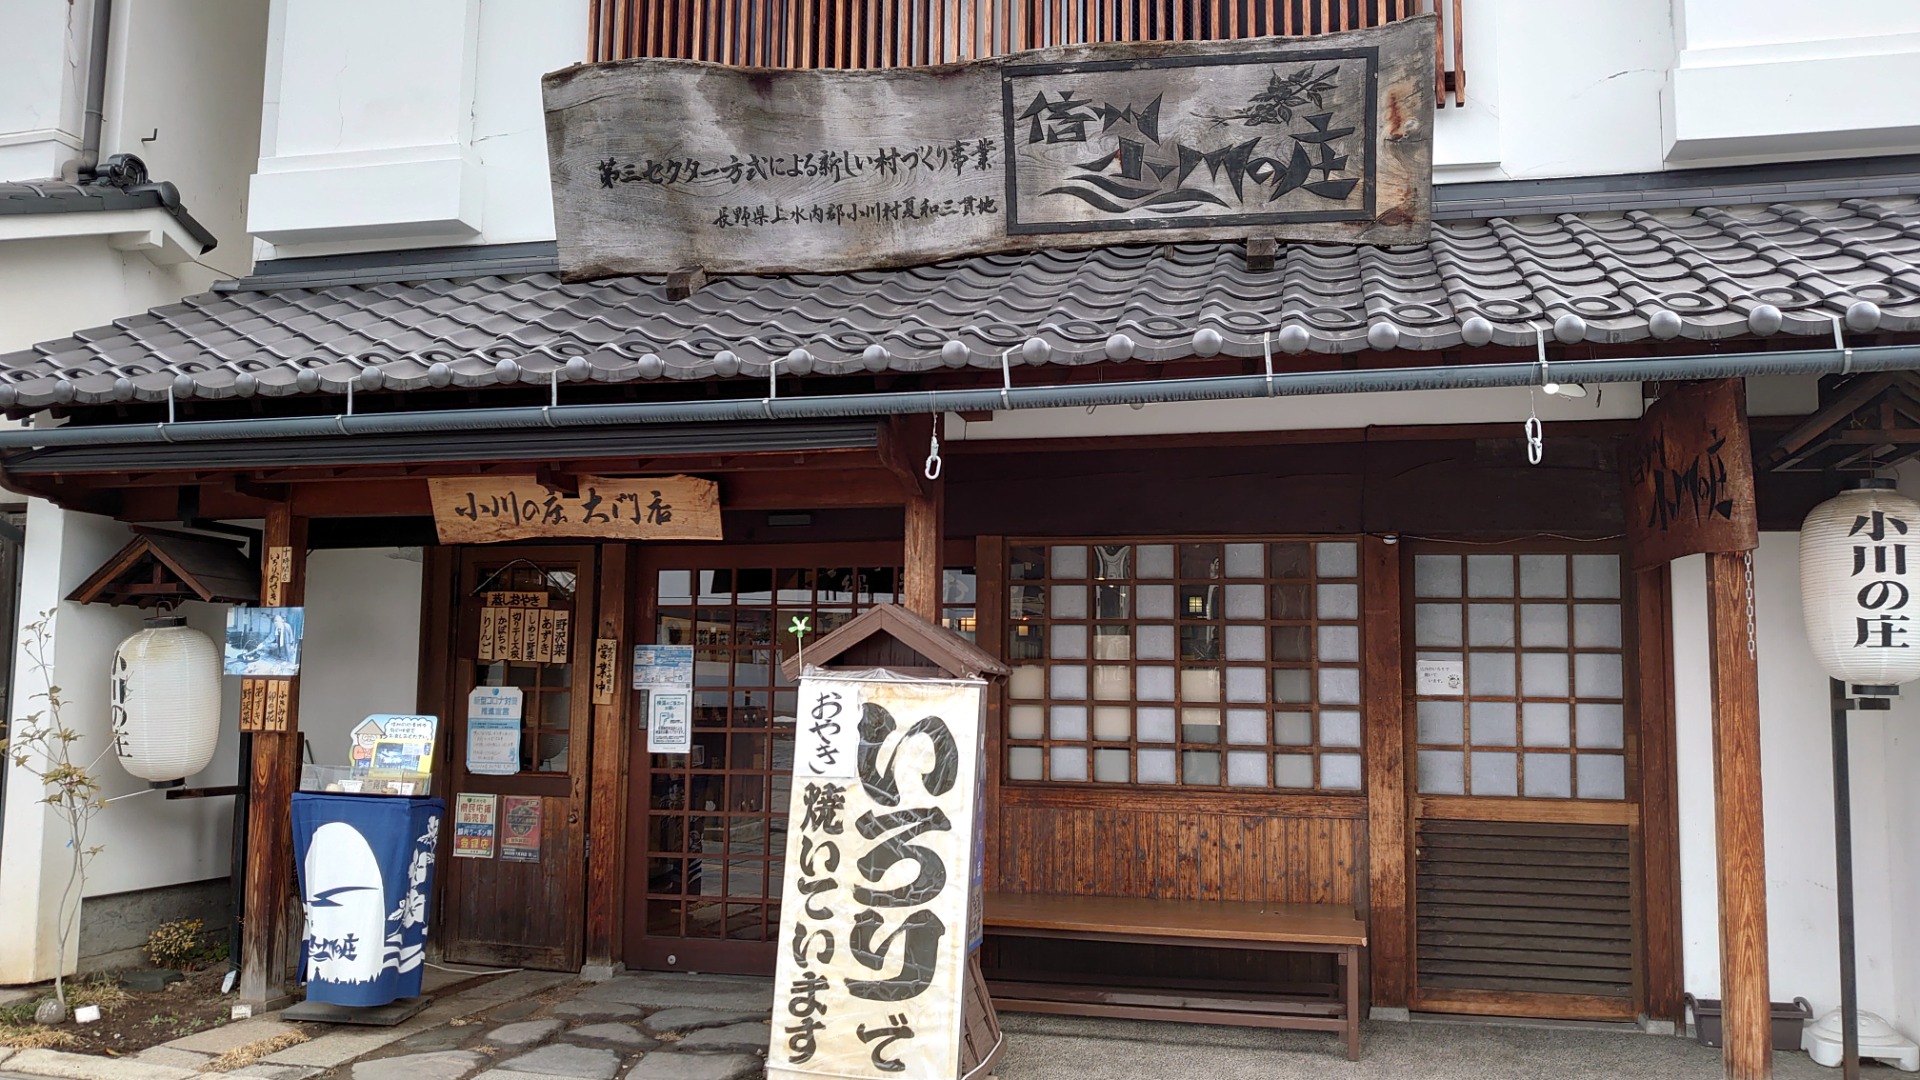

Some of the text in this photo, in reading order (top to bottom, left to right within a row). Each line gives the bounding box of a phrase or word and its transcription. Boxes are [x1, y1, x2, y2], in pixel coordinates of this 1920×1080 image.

[1017, 90, 1163, 145] 信州
[598, 137, 997, 190] 第三セクター方式による新しい村づくり事業
[1073, 112, 1360, 203] 小川の庄
[454, 487, 673, 526] 小川の庄 大門店
[491, 593, 540, 607] 蒸しおやき
[1847, 510, 1911, 649] 小川の庄
[481, 616, 491, 654] りんご
[498, 616, 507, 654] かぼちゃ
[541, 615, 552, 655] あずき
[553, 618, 567, 657] 野沢菜
[596, 643, 608, 697] 営業中
[242, 688, 252, 724] 野沢菜
[253, 686, 263, 725] あずき
[809, 691, 842, 775] おやき
[843, 701, 959, 1072] いろりで
[784, 781, 847, 1065] 焼いています
